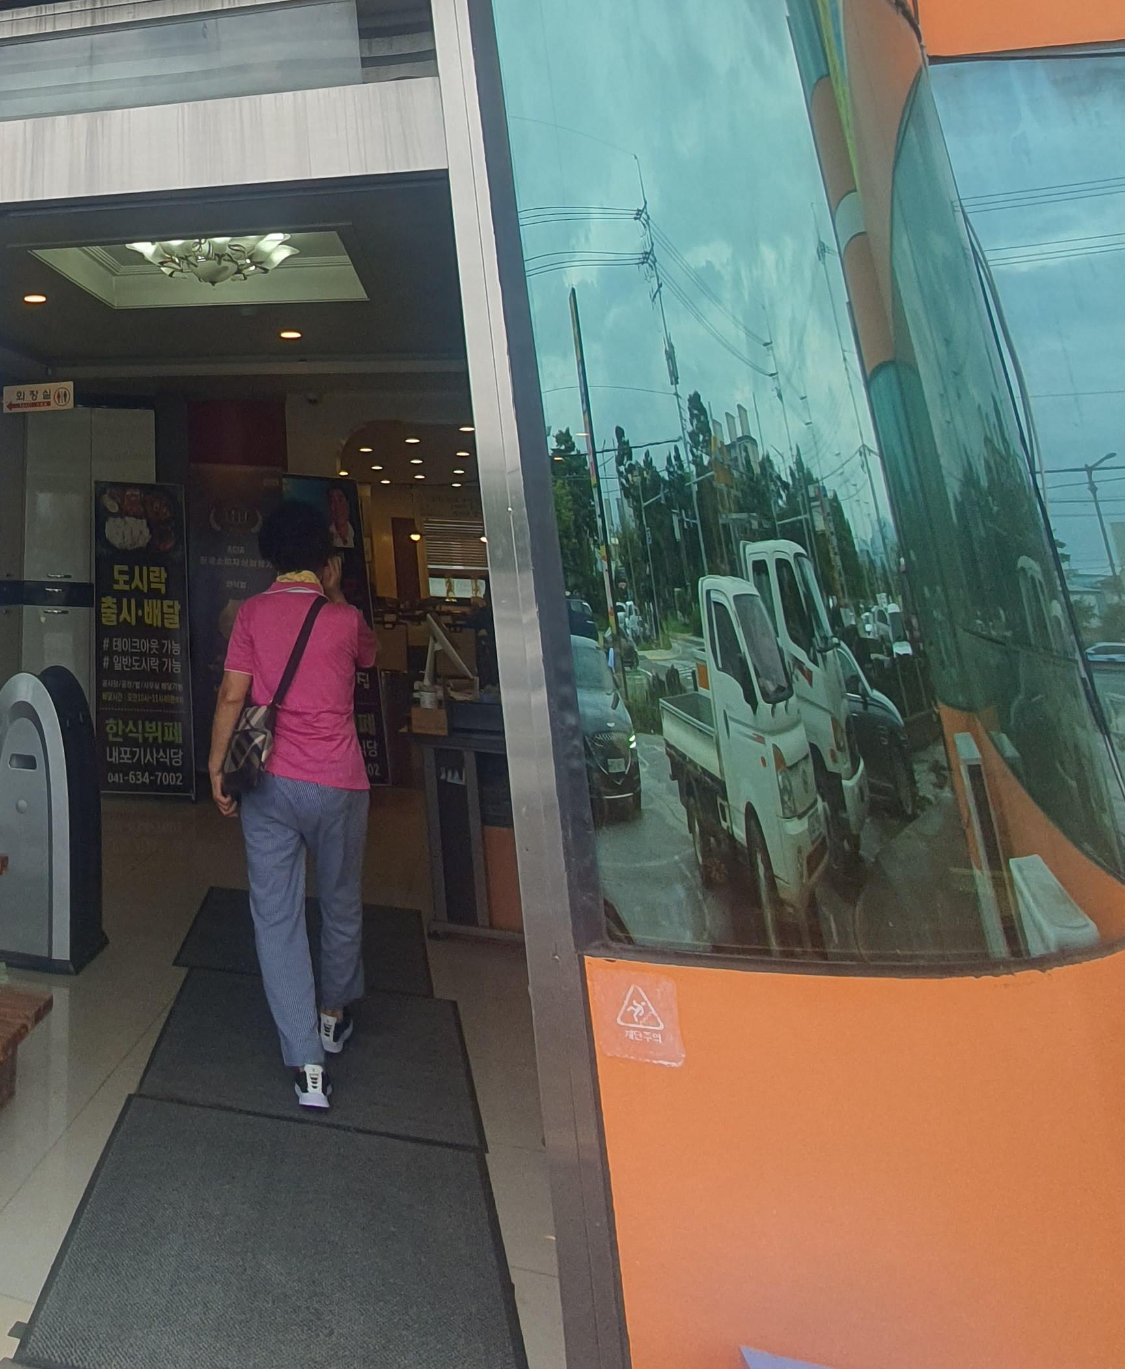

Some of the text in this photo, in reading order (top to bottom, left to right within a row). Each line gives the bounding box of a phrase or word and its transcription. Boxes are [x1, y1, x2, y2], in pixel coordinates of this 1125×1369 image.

[113, 564, 167, 595] 도시락
[112, 637, 160, 654] 테이크아웃
[162, 639, 181, 655] 가능
[113, 655, 159, 672] 일반도시락
[162, 658, 181, 674] 가능
[105, 718, 183, 744] 한식뷔페
[106, 746, 183, 767] 내포기사식당
[107, 771, 183, 786] 041-634-7002
